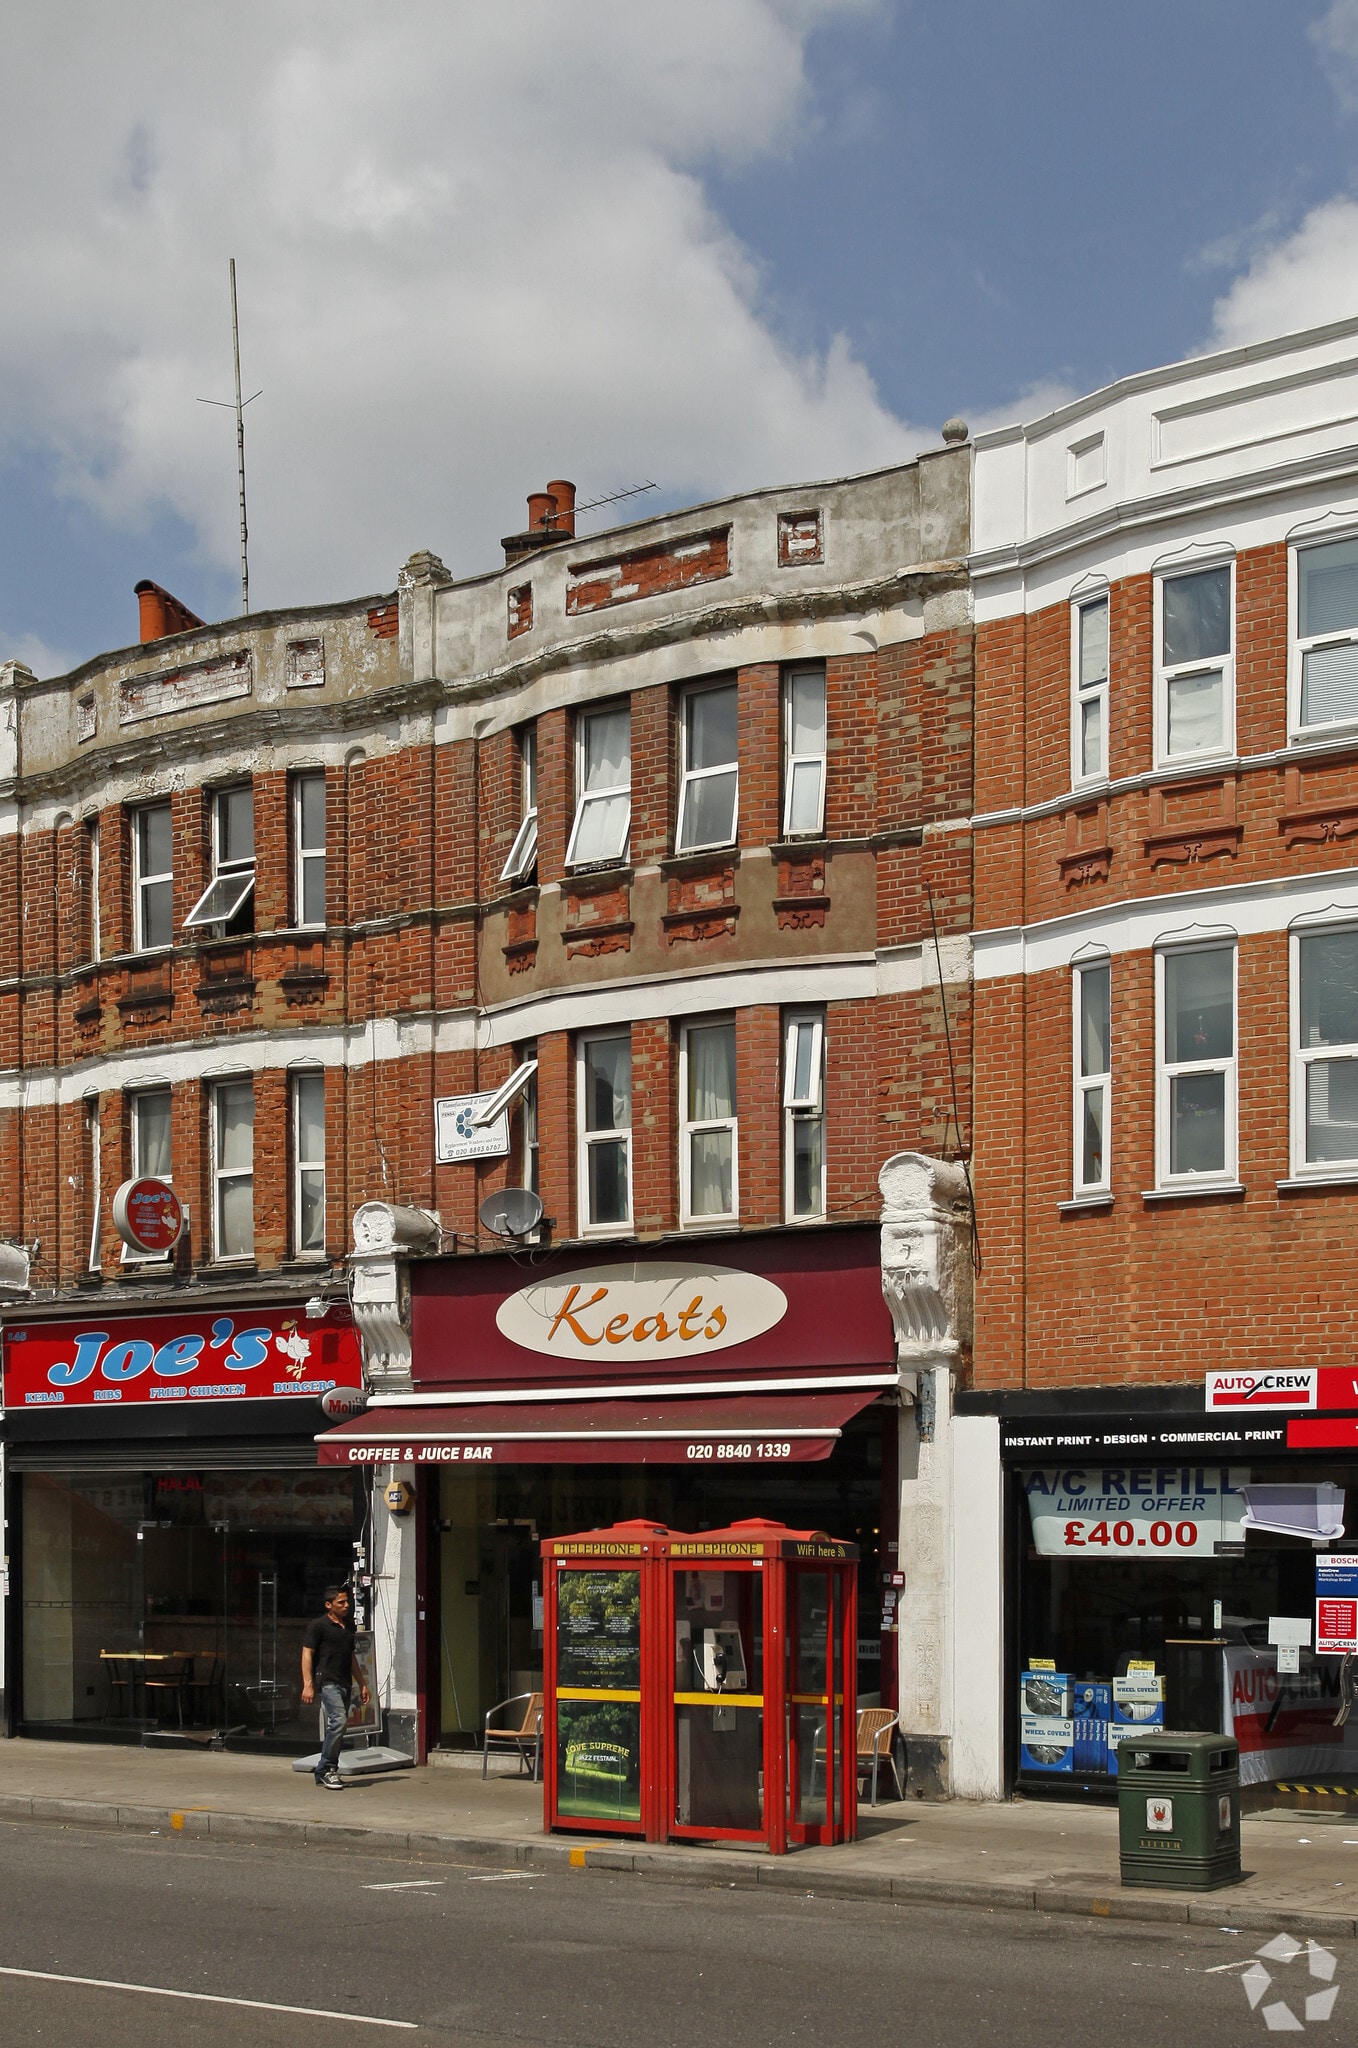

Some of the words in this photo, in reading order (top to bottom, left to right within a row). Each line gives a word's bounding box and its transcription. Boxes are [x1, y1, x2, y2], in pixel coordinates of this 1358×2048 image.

[131, 1191, 171, 1205] Joe's
[548, 1285, 727, 1346] Keats
[7, 1332, 27, 1341] 145
[47, 1317, 273, 1387] Joe's
[273, 1380, 336, 1394] BURGERS
[1213, 1377, 1256, 1390] AUTO
[1263, 1375, 1311, 1389] CREW
[25, 1391, 64, 1403] KEBAB
[93, 1389, 122, 1400] RIBS
[150, 1386, 187, 1399] FRIED
[189, 1383, 246, 1396] CHICKEN
[1004, 1436, 1054, 1446] INSTANT
[1056, 1435, 1092, 1445] PRINT
[1103, 1434, 1148, 1444] DESIGN
[1160, 1431, 1242, 1443] COMMERCIAL
[1245, 1430, 1283, 1440] PRINT
[349, 1448, 400, 1461] COFFEE
[403, 1447, 414, 1461] &
[418, 1446, 460, 1460] JUICE
[463, 1446, 493, 1460] BAR
[687, 1445, 713, 1459] 020
[717, 1444, 752, 1458] 8840
[756, 1443, 791, 1457] 1339
[157, 1476, 203, 1491] HALAL
[1025, 1469, 1087, 1496] A/C
[1101, 1468, 1241, 1496] REFILL
[1057, 1497, 1131, 1512] LIMITED
[1141, 1497, 1206, 1512] OFFER
[1063, 1520, 1199, 1547] £40.00
[559, 1543, 636, 1555] TELEPHONE
[676, 1543, 759, 1555] TELEPHONE
[797, 1544, 815, 1556] WiFi
[818, 1544, 836, 1557] here
[1232, 1667, 1279, 1705] AUTO
[565, 1743, 587, 1755] LOVE
[589, 1741, 630, 1757] SUPREME
